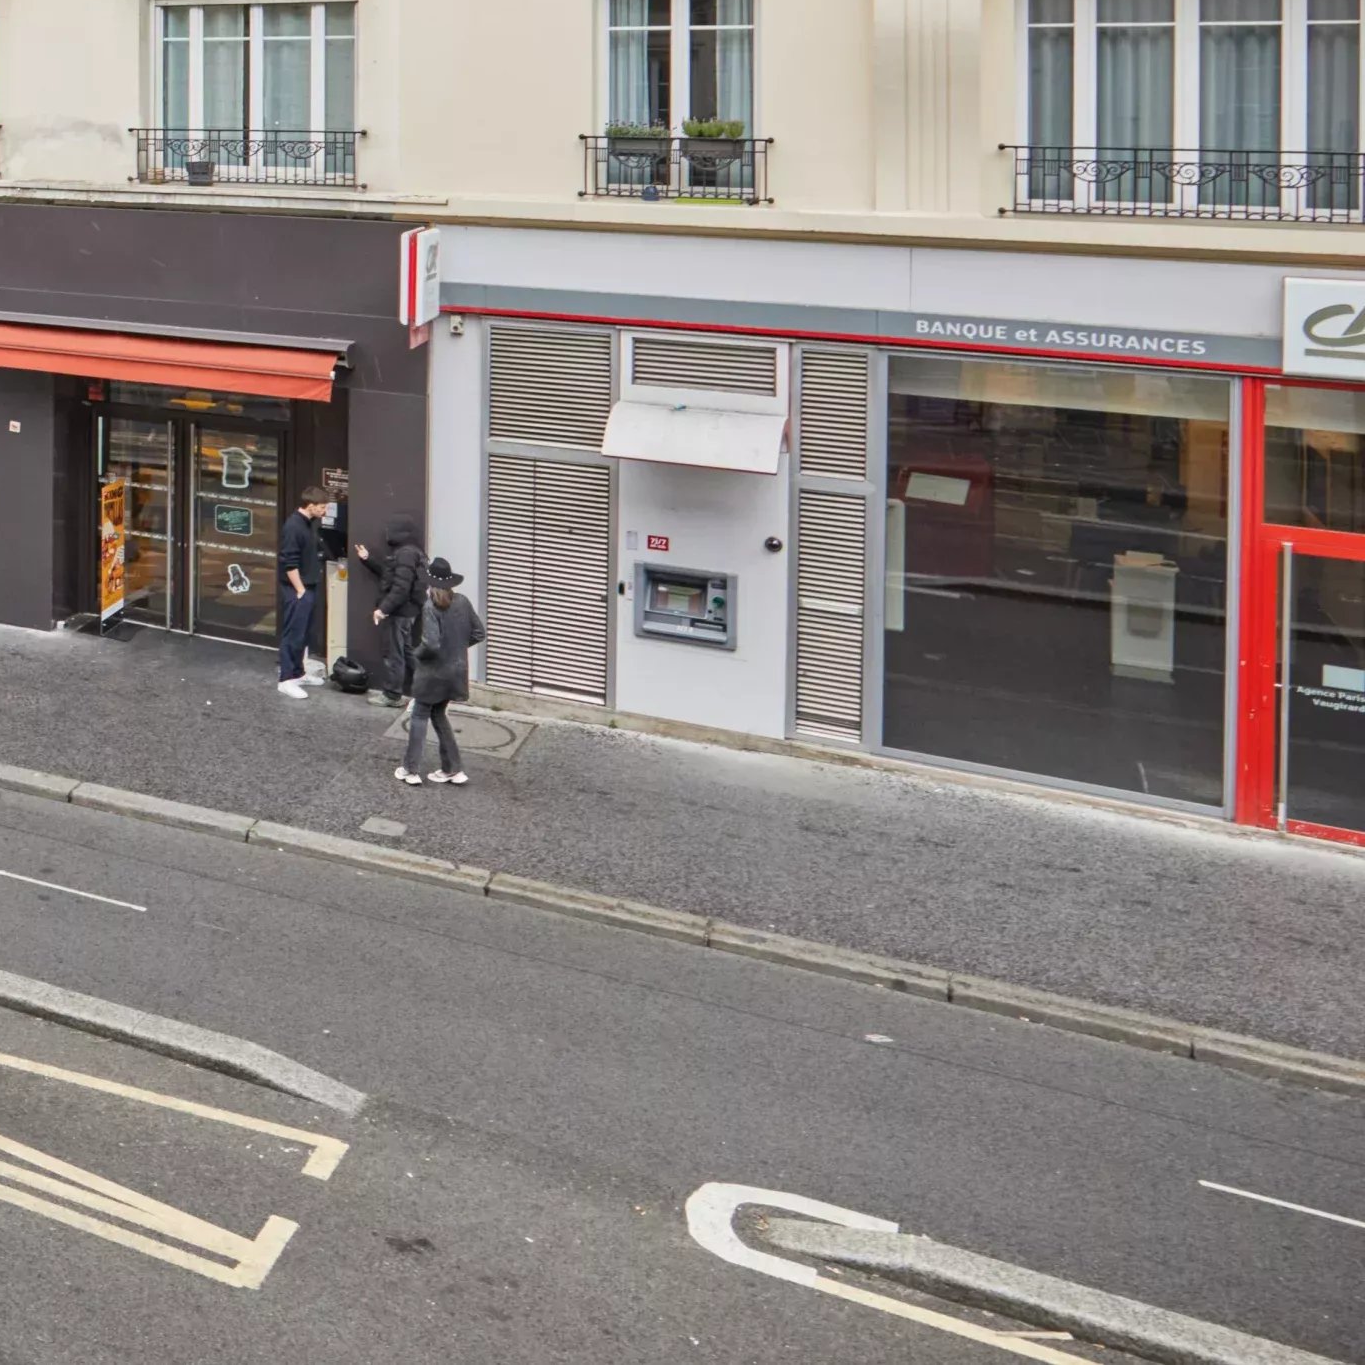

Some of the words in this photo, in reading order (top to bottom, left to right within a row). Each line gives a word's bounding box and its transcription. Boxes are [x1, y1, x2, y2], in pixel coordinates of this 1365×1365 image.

[915, 319, 1007, 340] BANQUE
[1015, 329, 1038, 342] et
[1045, 329, 1207, 355] ASSURANCES
[1296, 686, 1336, 696] Agence
